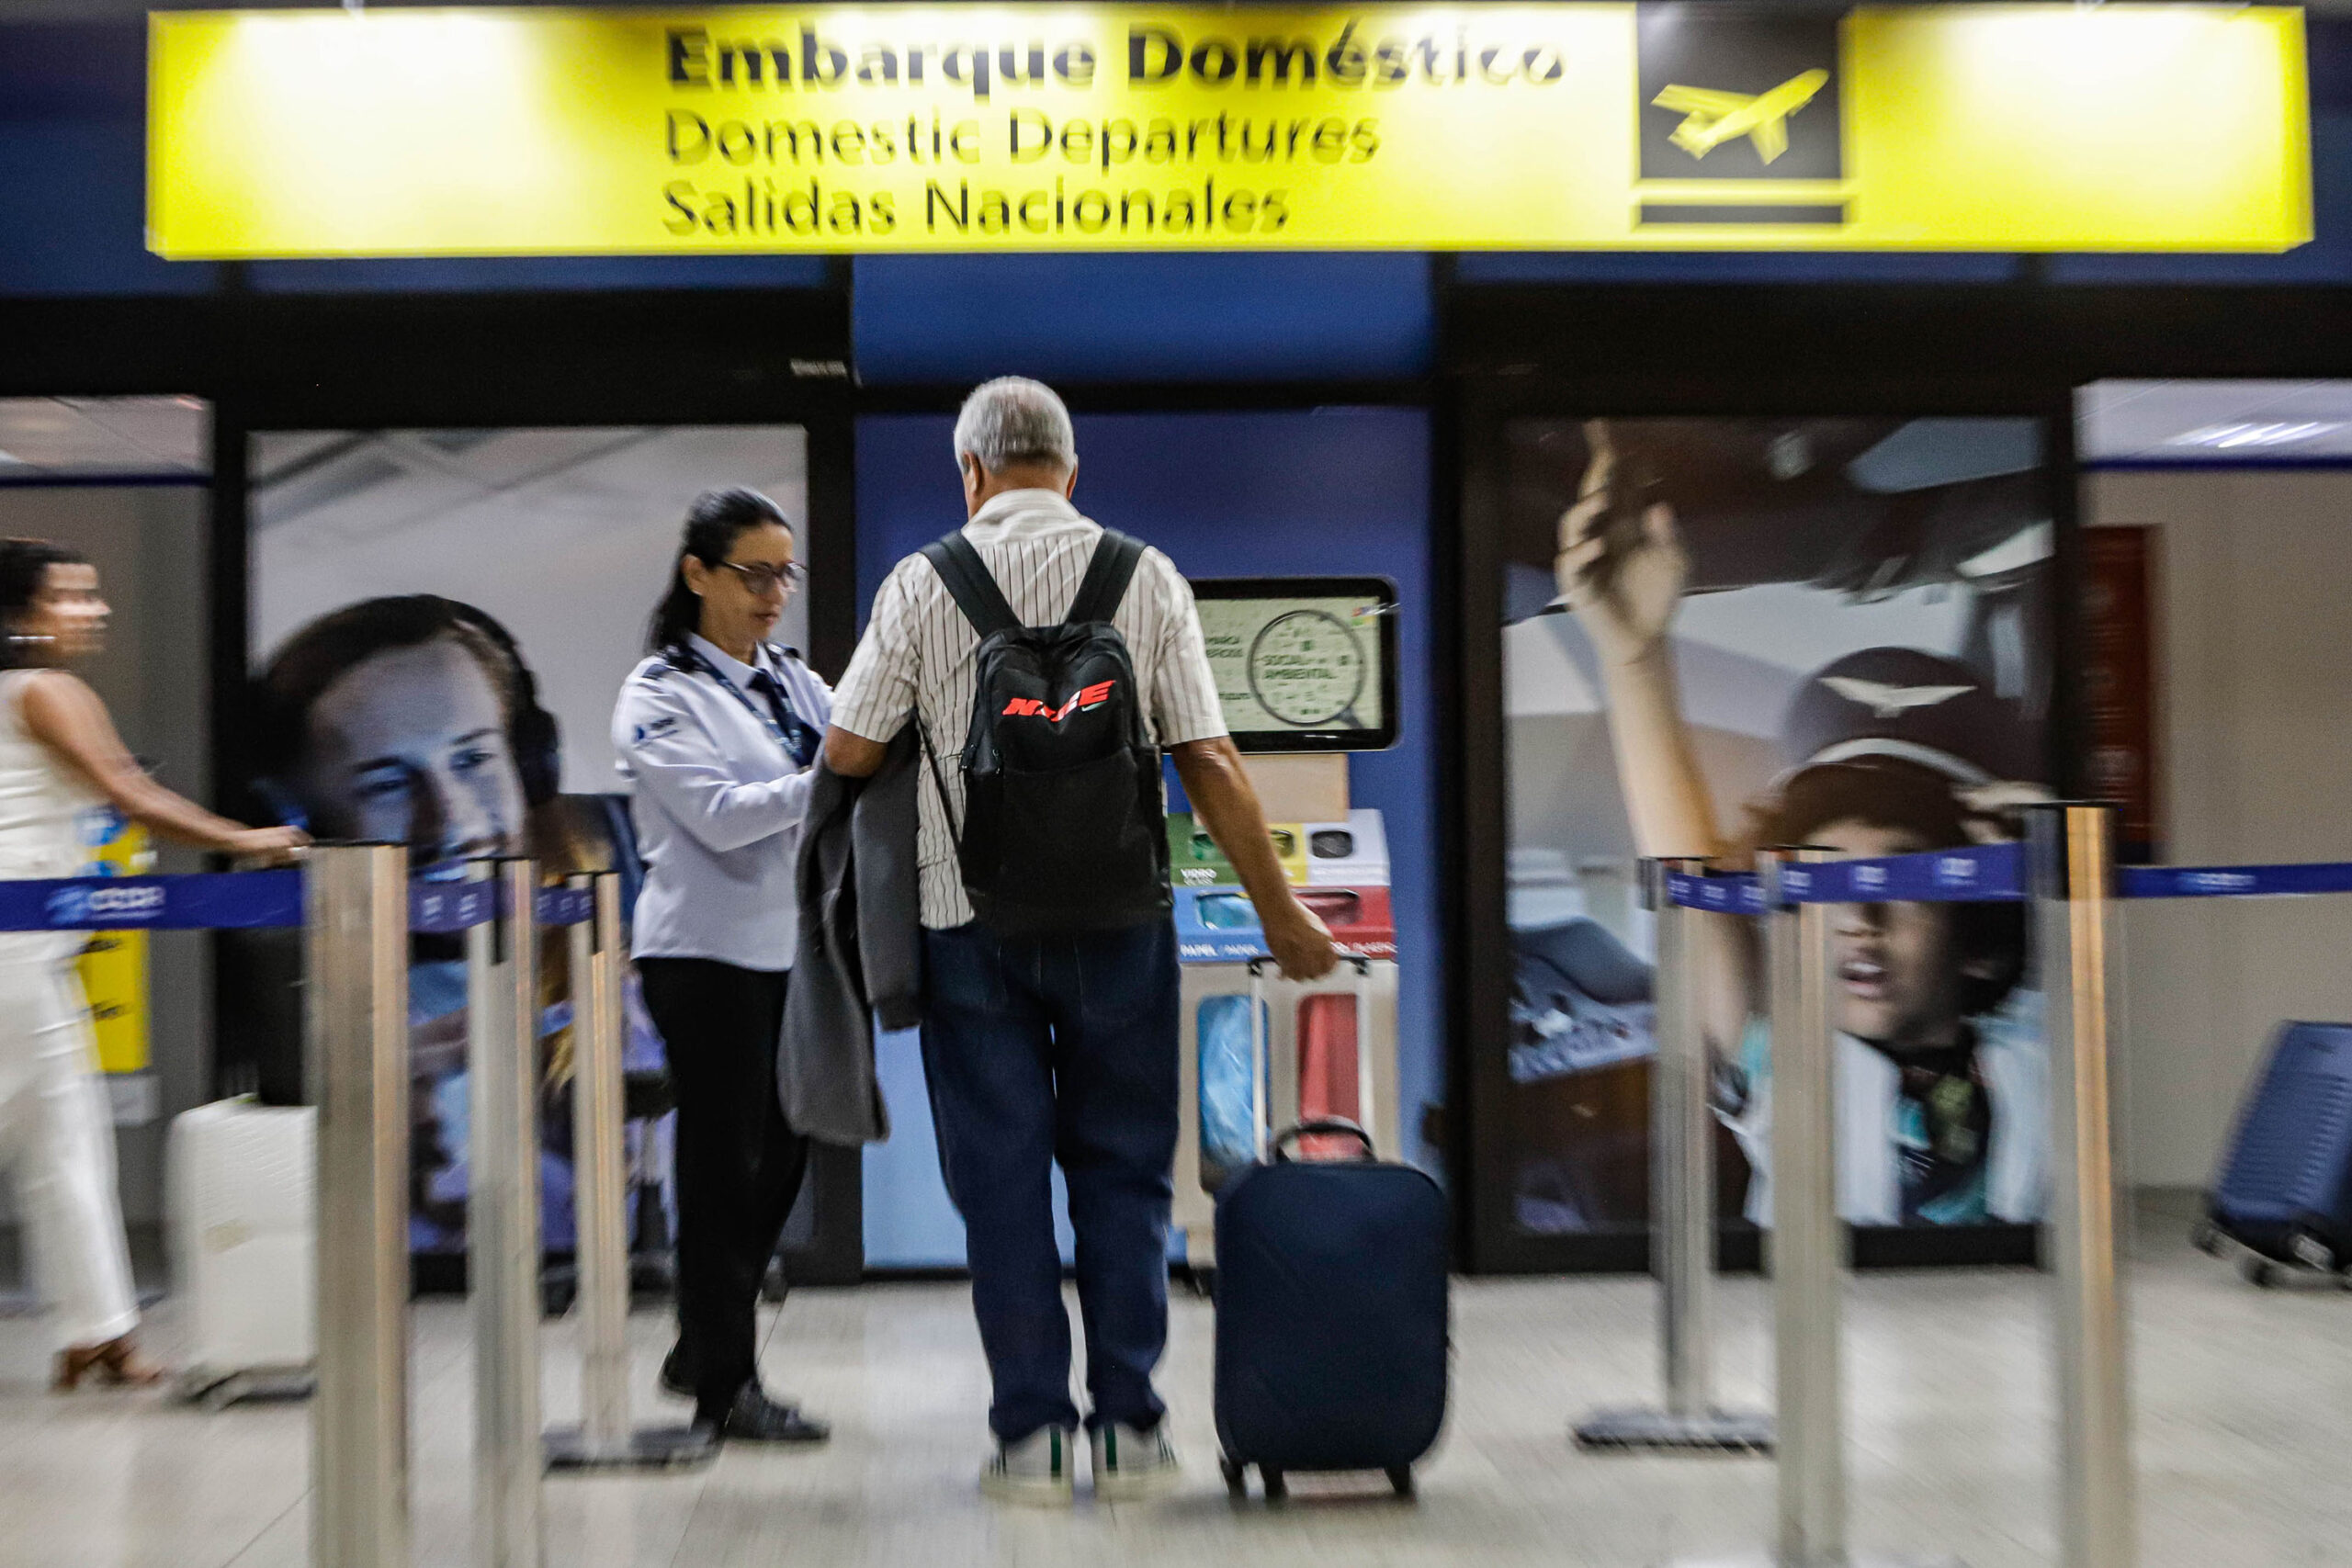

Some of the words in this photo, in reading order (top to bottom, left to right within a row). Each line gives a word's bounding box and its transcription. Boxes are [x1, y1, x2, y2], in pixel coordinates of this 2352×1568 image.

[668, 22, 1096, 103] Embarque
[1128, 17, 1564, 90] Doméstico
[665, 107, 980, 165] Domestic
[1009, 107, 1380, 175] Departures
[662, 175, 897, 236] Salidas
[925, 175, 1288, 234] Nacionales
